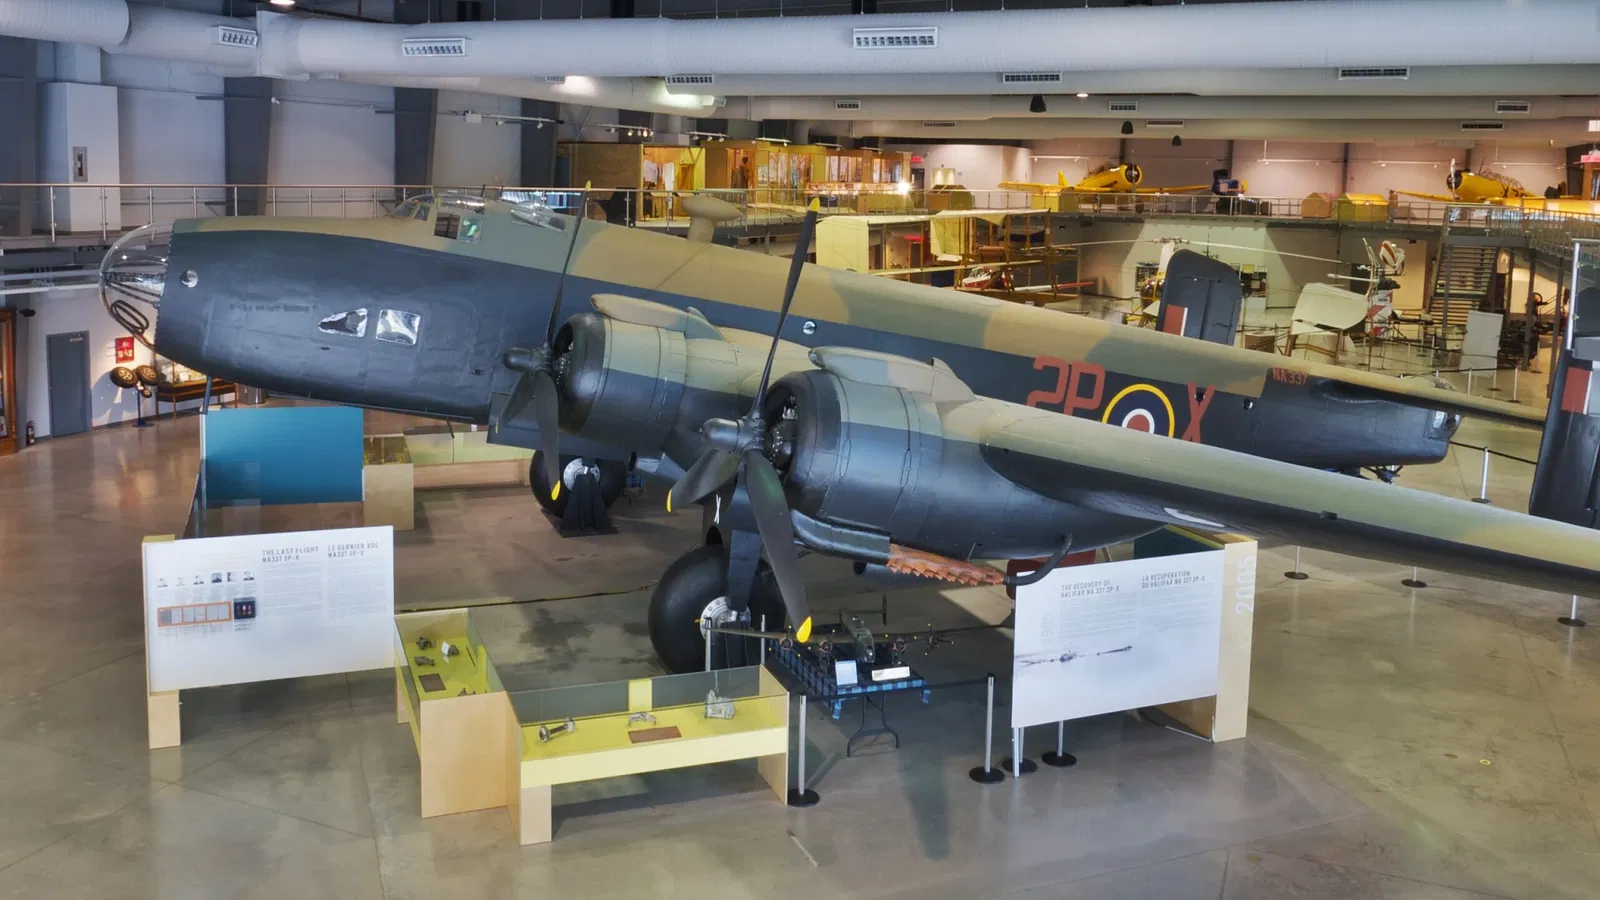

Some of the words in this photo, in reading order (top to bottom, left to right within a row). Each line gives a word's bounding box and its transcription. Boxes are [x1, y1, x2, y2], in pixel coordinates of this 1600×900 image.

[1273, 367, 1307, 386] NA337
[1027, 355, 1106, 416] 2P
[1182, 381, 1216, 444] X
[296, 546, 319, 554] FLIGHT
[338, 543, 364, 551] DERNIER
[262, 555, 282, 563] NA337
[1073, 580, 1102, 589] RECOVERY
[1061, 589, 1085, 598] HALIFAX
